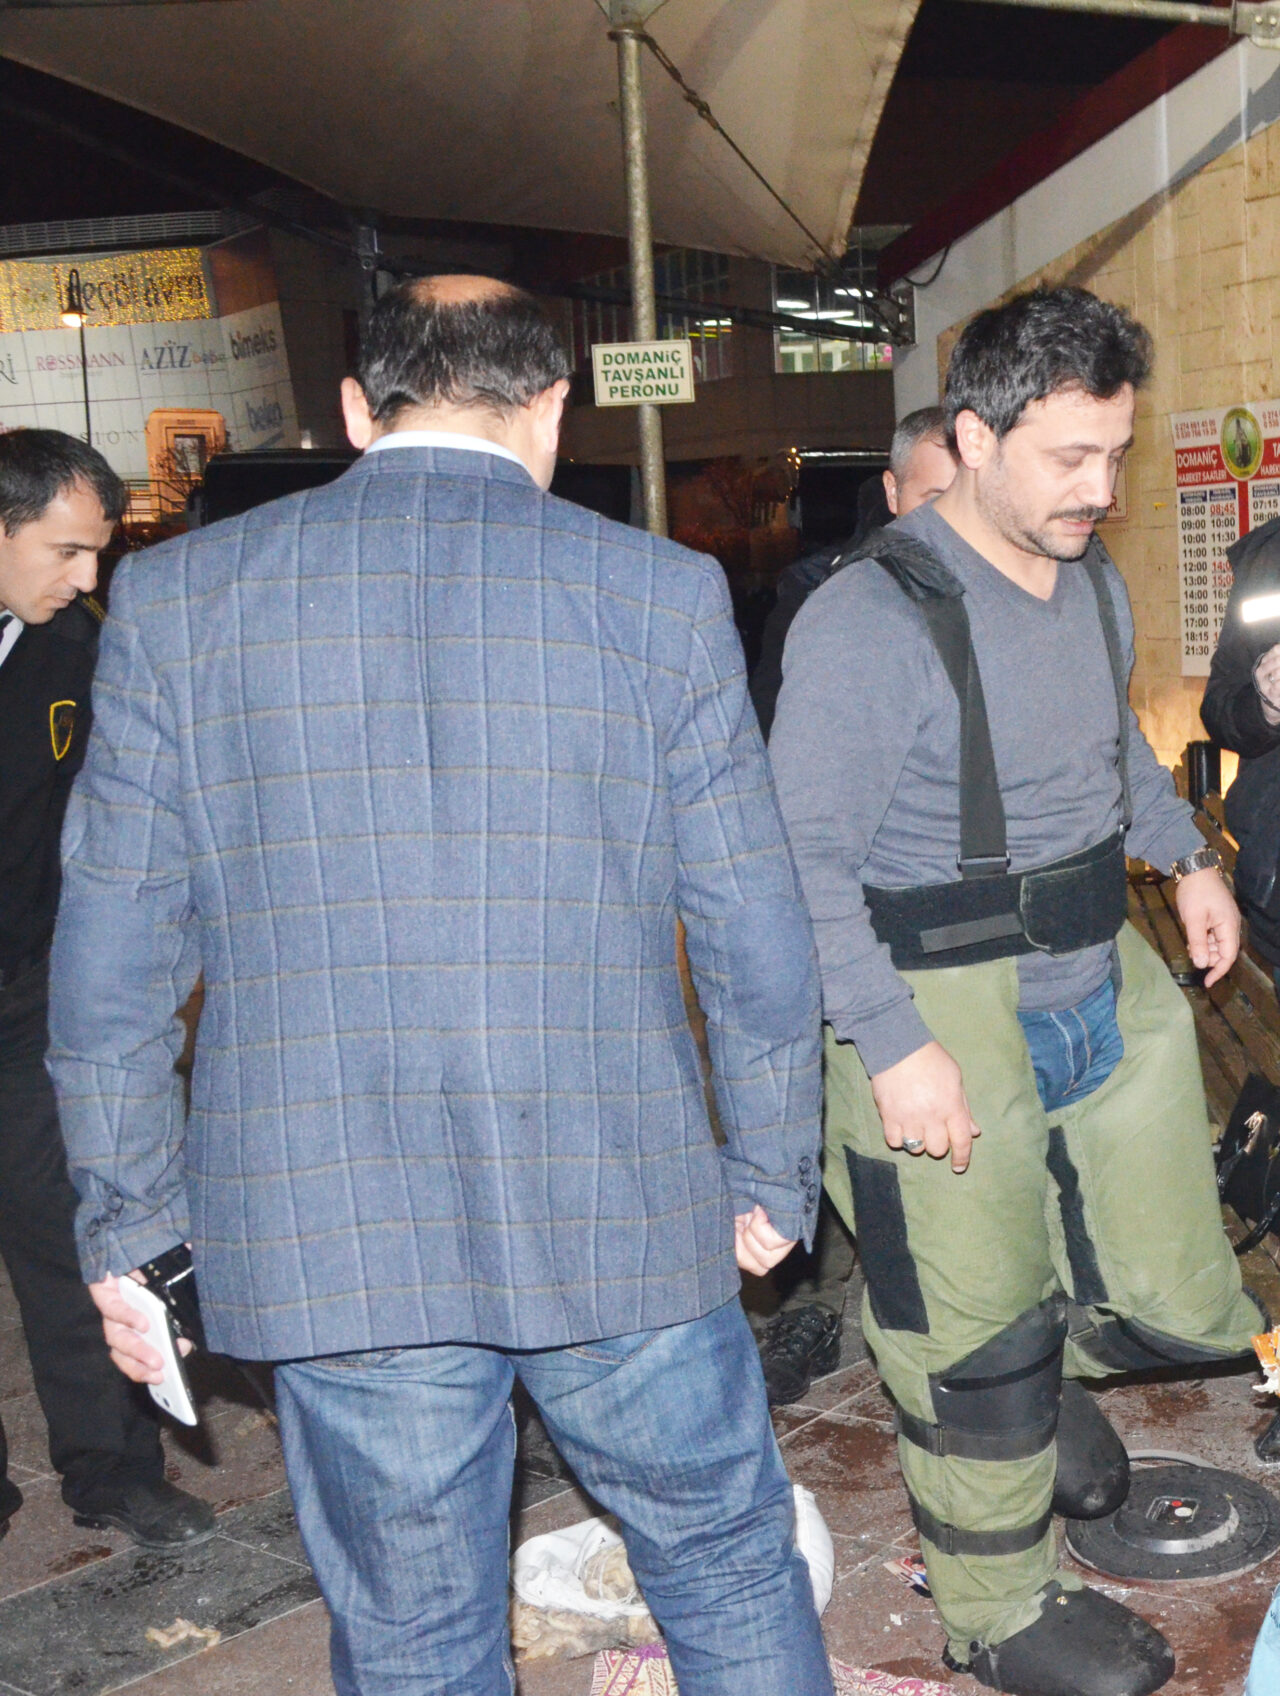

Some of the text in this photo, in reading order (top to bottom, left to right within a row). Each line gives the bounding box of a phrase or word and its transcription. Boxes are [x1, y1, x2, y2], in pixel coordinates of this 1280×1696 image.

[601, 366, 685, 384] TAVŞANLI
[609, 383, 679, 398] PERONU
[1177, 447, 1218, 468] DOMANİÇ
[1181, 503, 1236, 516] 08:00 08:45
[1253, 499, 1278, 509] 07:15
[1181, 517, 1236, 530] 09:00 10:00
[1182, 531, 1236, 544] 10:00 11:30
[1183, 546, 1227, 558] 11:00 13:
[1183, 560, 1232, 572] 12:00 14:0
[1184, 575, 1208, 586] 13:00
[1184, 589, 1208, 600] 14:00
[1184, 603, 1209, 614] 15:00
[1185, 617, 1209, 628] 17:00
[1185, 631, 1209, 641] 18:15
[1185, 645, 1209, 656] 21:30
